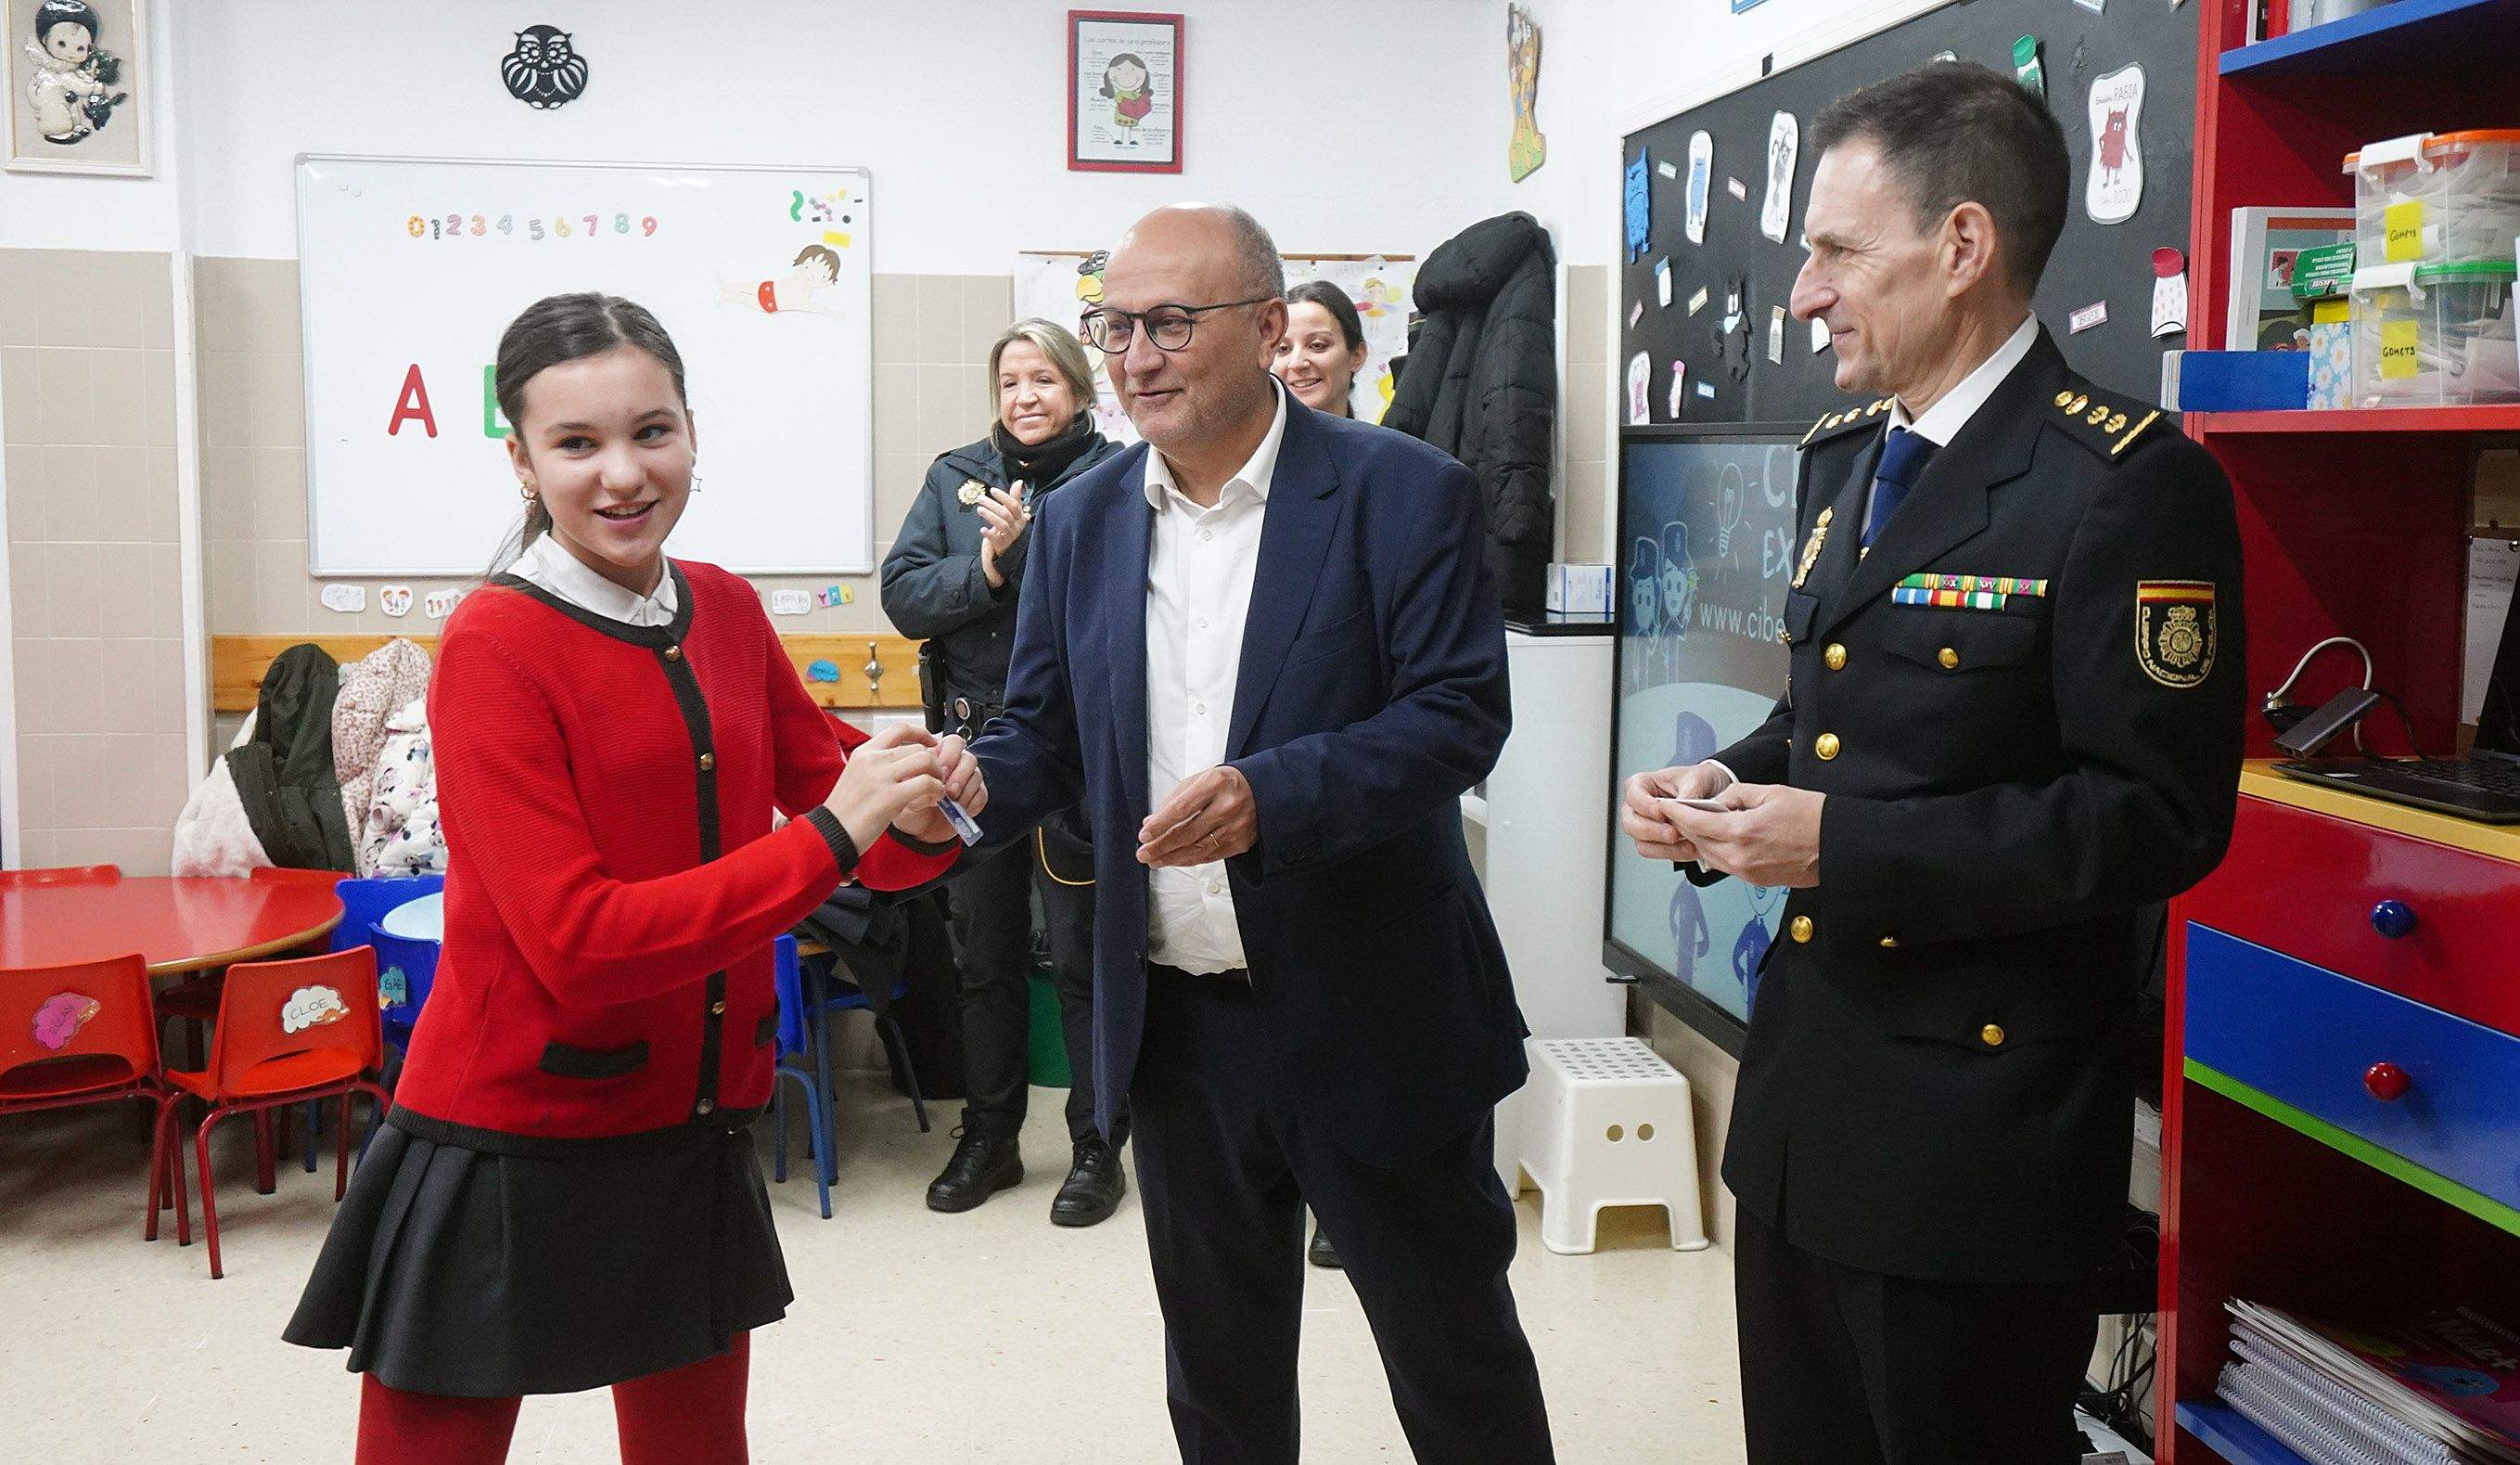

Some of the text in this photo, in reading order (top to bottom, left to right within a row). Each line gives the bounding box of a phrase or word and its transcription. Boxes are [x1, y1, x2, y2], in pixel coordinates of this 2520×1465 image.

[2383, 346, 2415, 357] GOMETS
[389, 364, 438, 438] A
[290, 998, 326, 1020] CLOE
